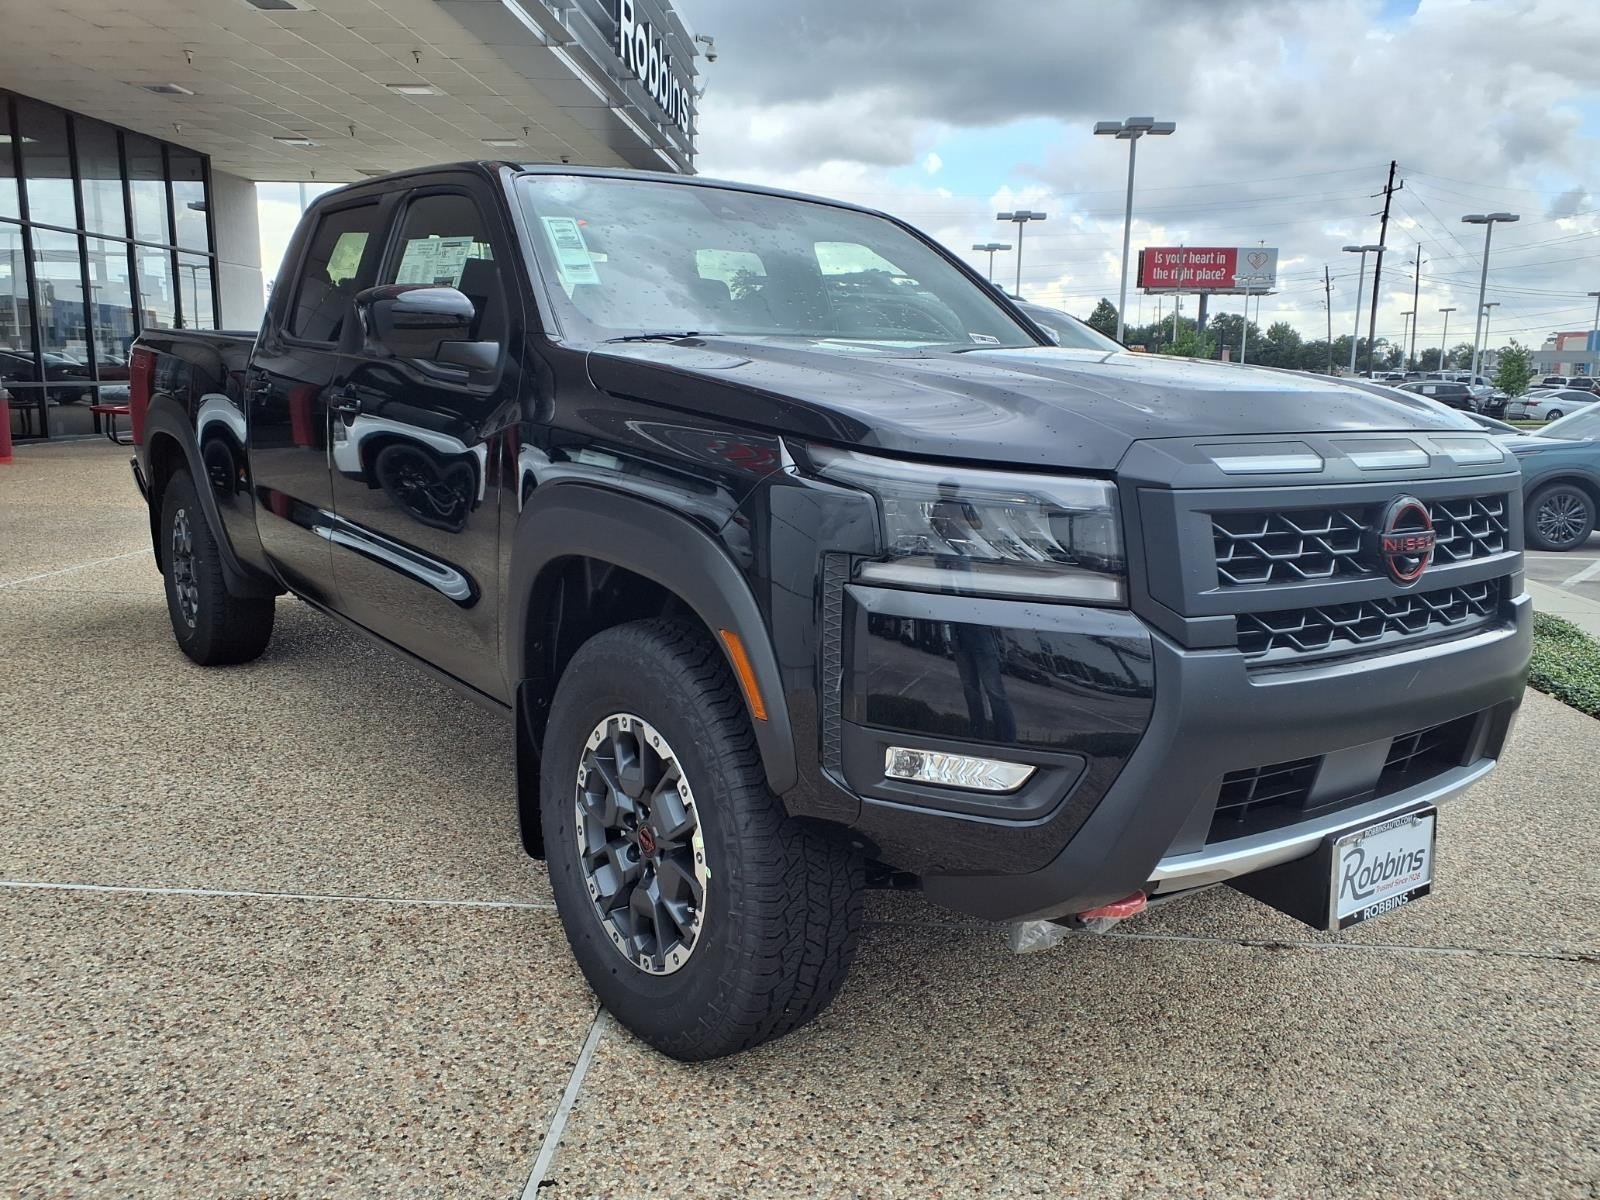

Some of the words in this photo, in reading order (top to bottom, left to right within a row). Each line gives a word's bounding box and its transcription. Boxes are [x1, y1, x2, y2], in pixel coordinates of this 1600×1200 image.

[620, 0, 689, 133] Robbins
[1155, 251, 1163, 264] Is
[1189, 251, 1214, 264] heart
[1216, 251, 1226, 264] in
[1153, 267, 1168, 280] the
[1196, 267, 1226, 281] place?
[1340, 848, 1426, 901] Robbins
[1363, 893, 1409, 921] ROBBINS
